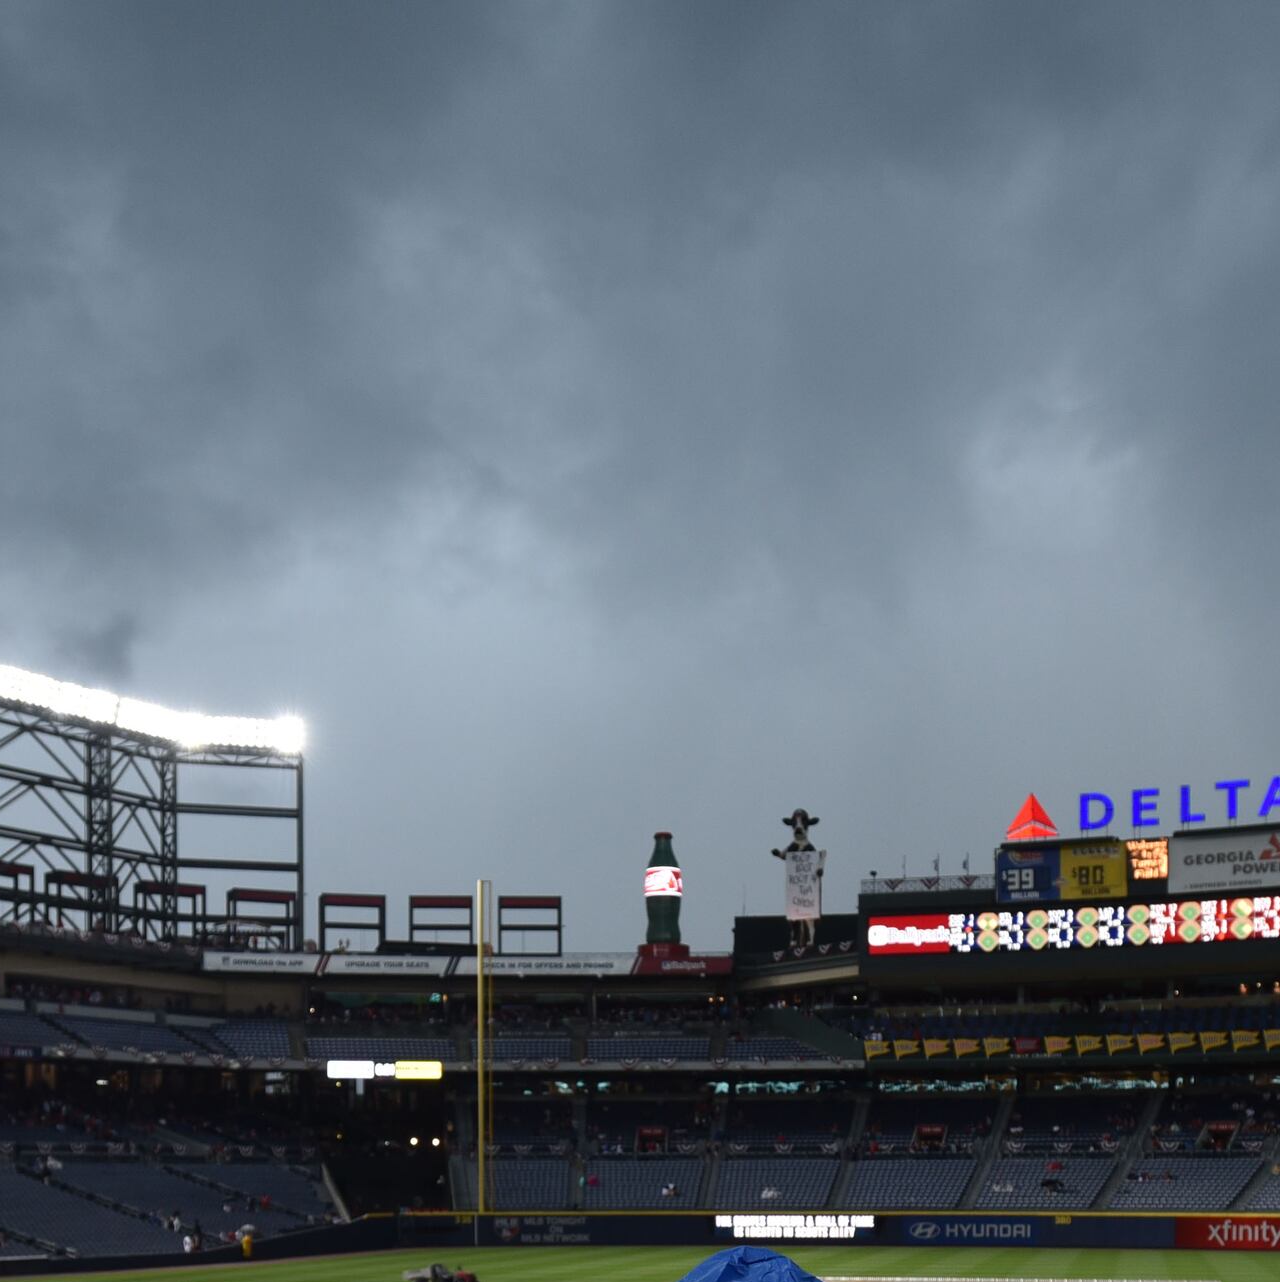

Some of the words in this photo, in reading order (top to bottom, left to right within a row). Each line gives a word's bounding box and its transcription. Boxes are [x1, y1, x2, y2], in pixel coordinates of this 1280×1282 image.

[1183, 850, 1256, 866] GEORGIA
[546, 1216, 587, 1225] TONIGHT
[945, 1223, 1031, 1238] HYUNDAI
[543, 1234, 590, 1242] NETWORK
